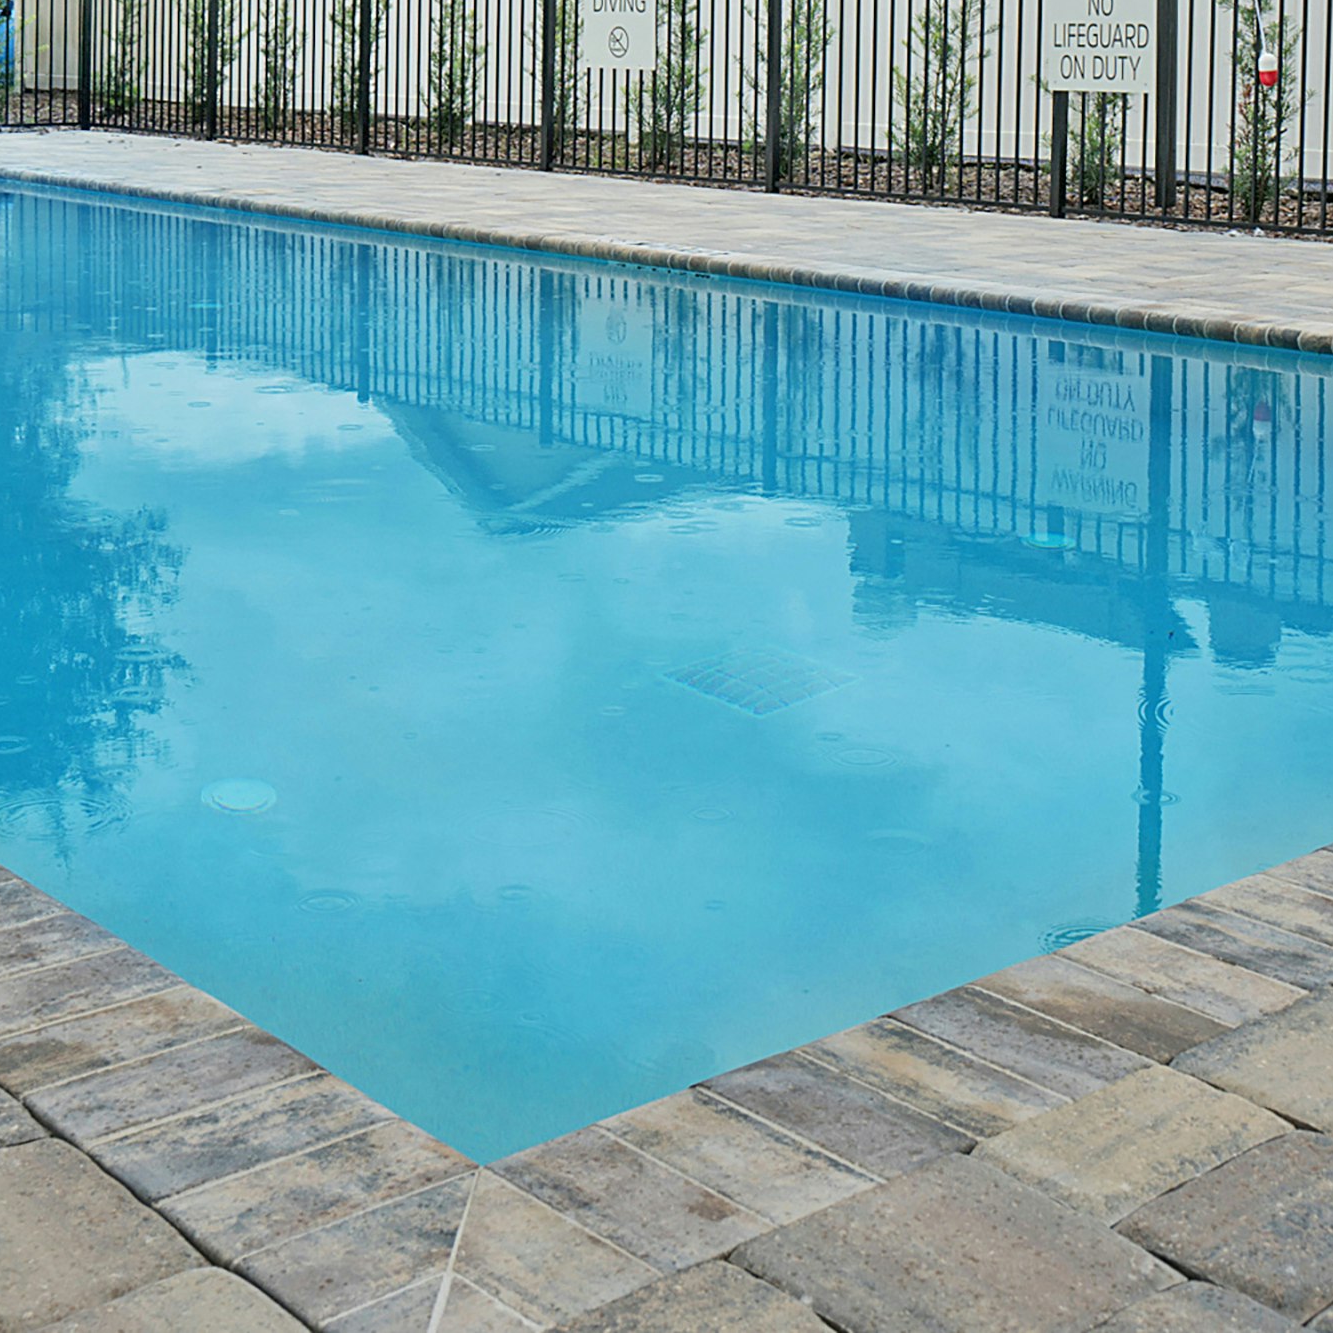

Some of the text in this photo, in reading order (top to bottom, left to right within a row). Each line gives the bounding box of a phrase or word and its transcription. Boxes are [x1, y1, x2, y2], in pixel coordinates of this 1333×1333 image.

[1053, 24, 1149, 48] LIFEGUARD
[1060, 54, 1141, 80] ON DUTY
